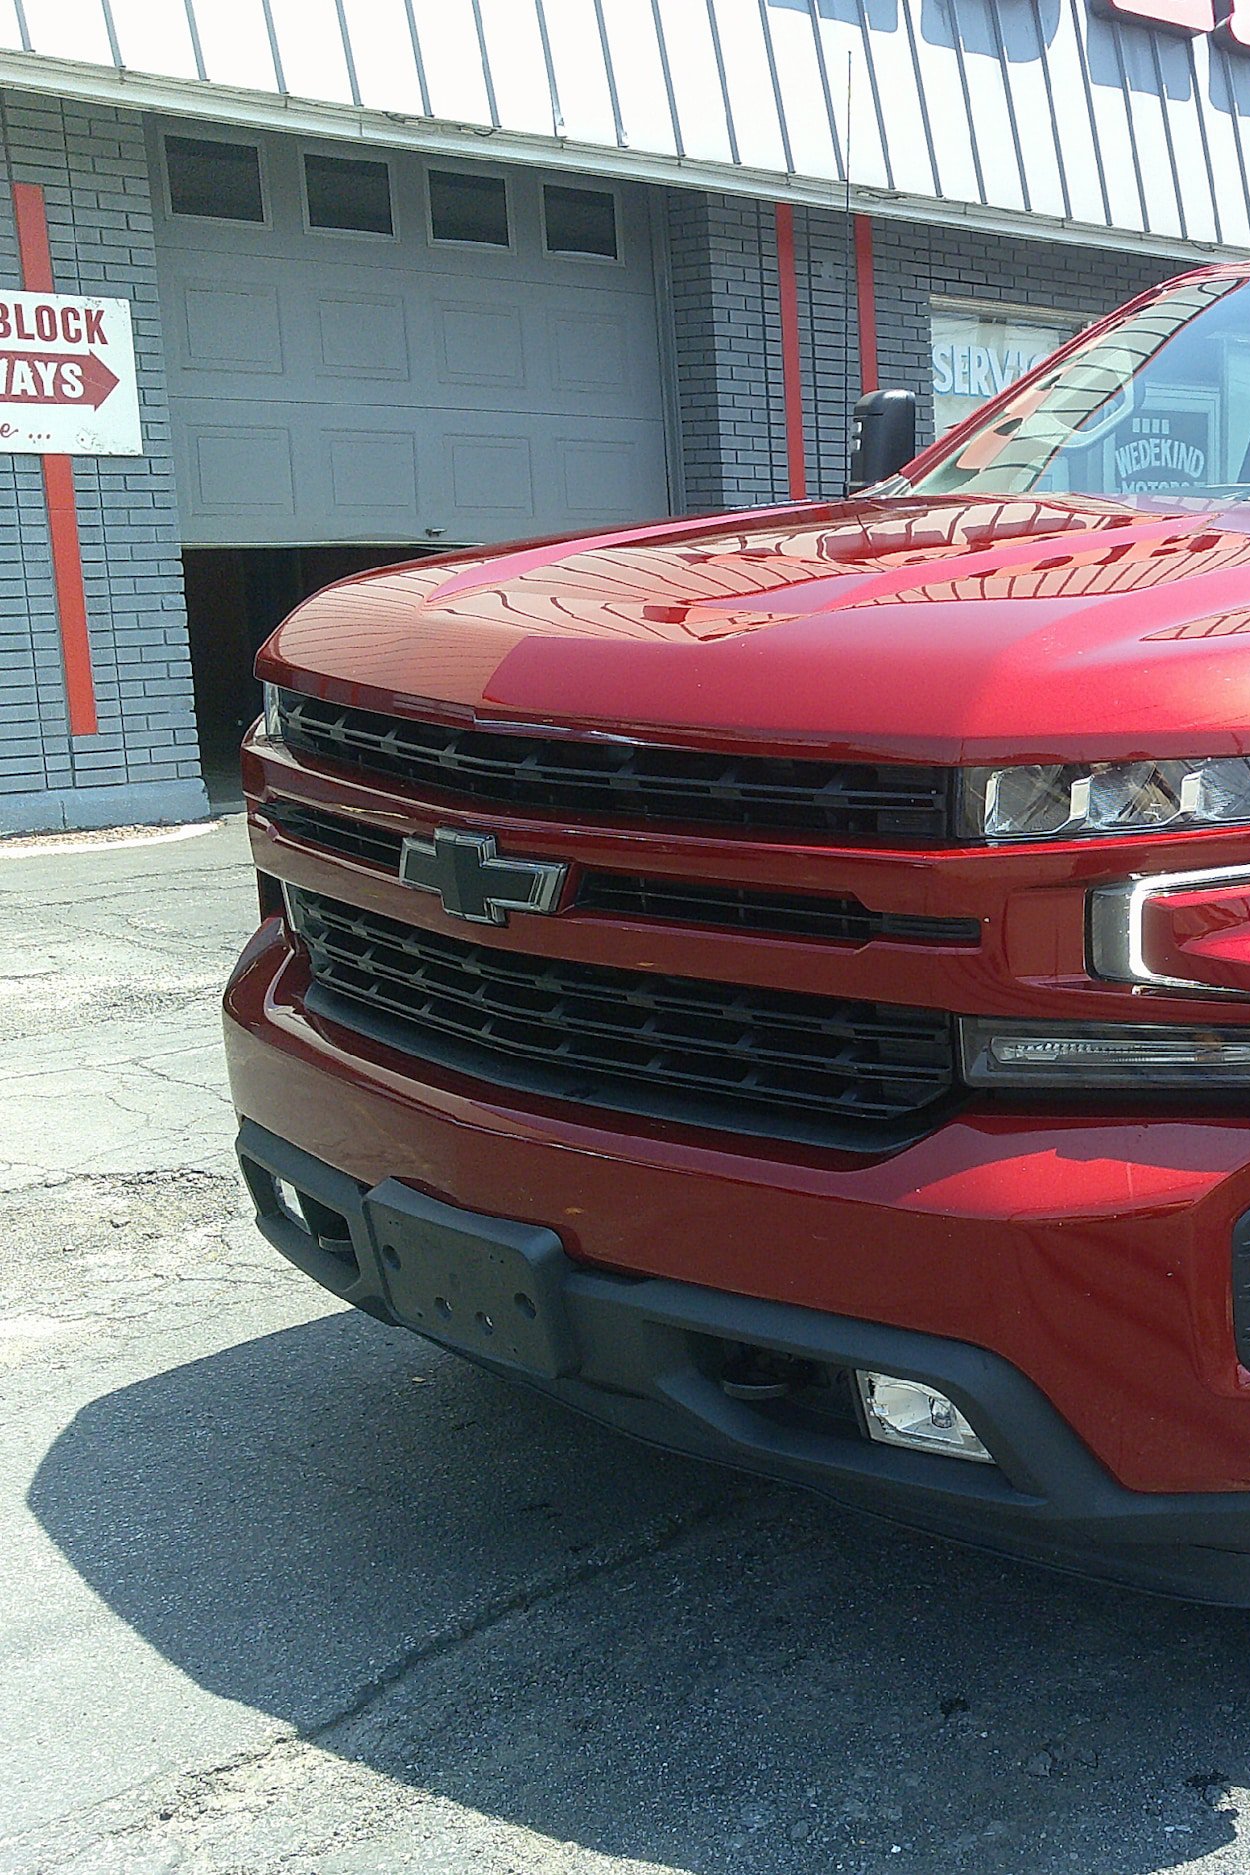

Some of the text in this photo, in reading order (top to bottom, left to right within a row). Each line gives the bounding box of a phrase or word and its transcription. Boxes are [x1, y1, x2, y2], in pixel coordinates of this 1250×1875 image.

[0, 302, 109, 346] BLOCK
[932, 343, 1050, 399] SERVI
[1115, 438, 1205, 479] WEDEKIND
